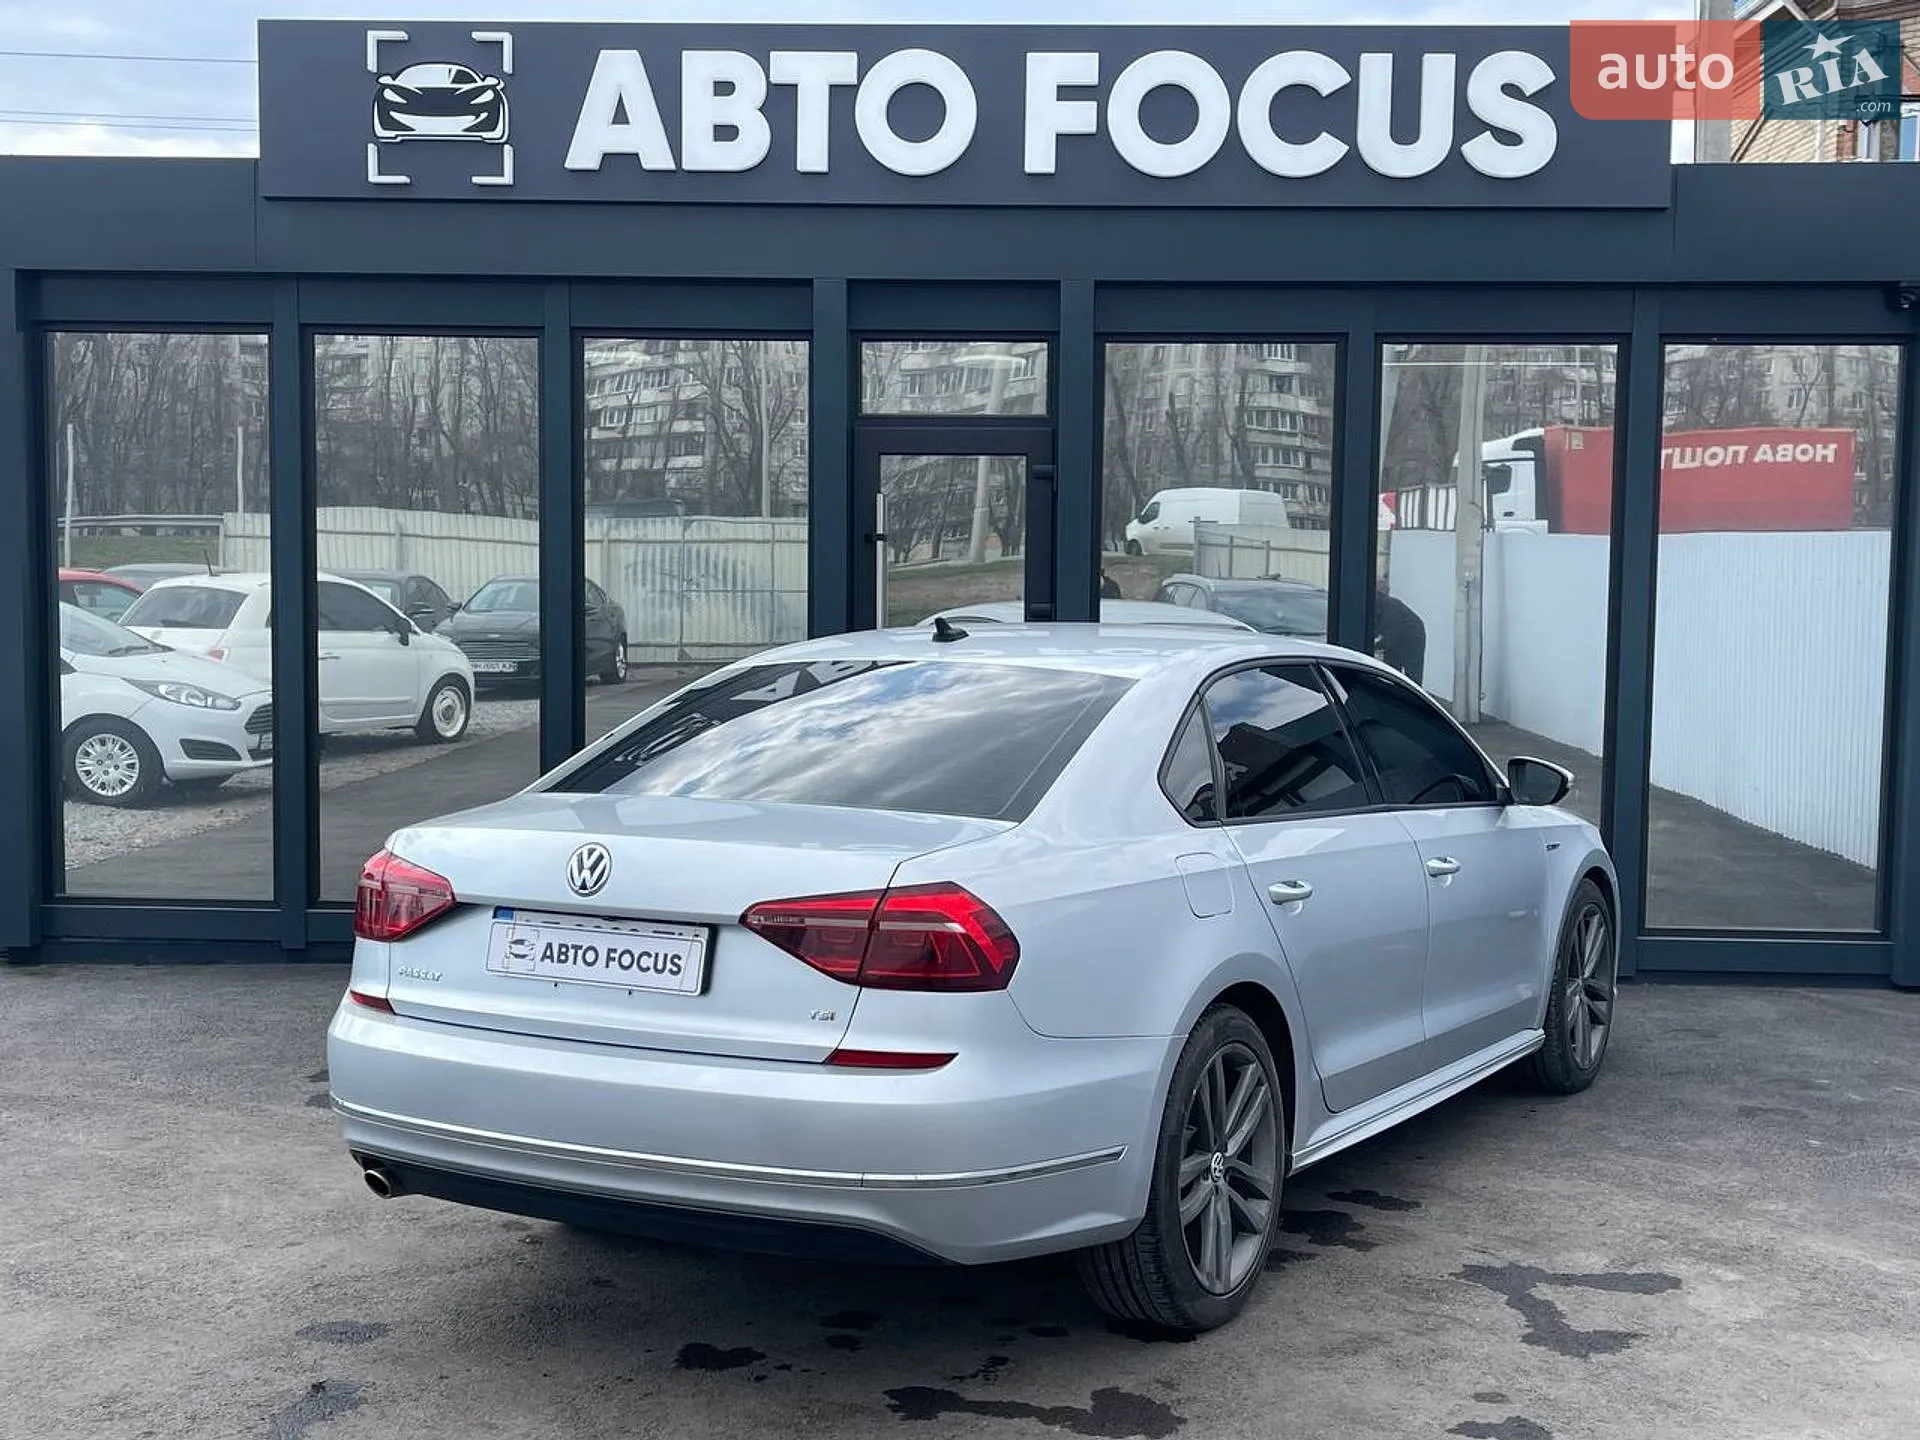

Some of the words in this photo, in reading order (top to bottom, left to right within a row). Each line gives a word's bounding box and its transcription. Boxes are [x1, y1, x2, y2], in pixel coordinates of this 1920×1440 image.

[563, 48, 978, 177] АВТО
[1023, 49, 1558, 179] FOCUS
[540, 942, 600, 968] АВТО
[605, 947, 683, 977] FOCUS
